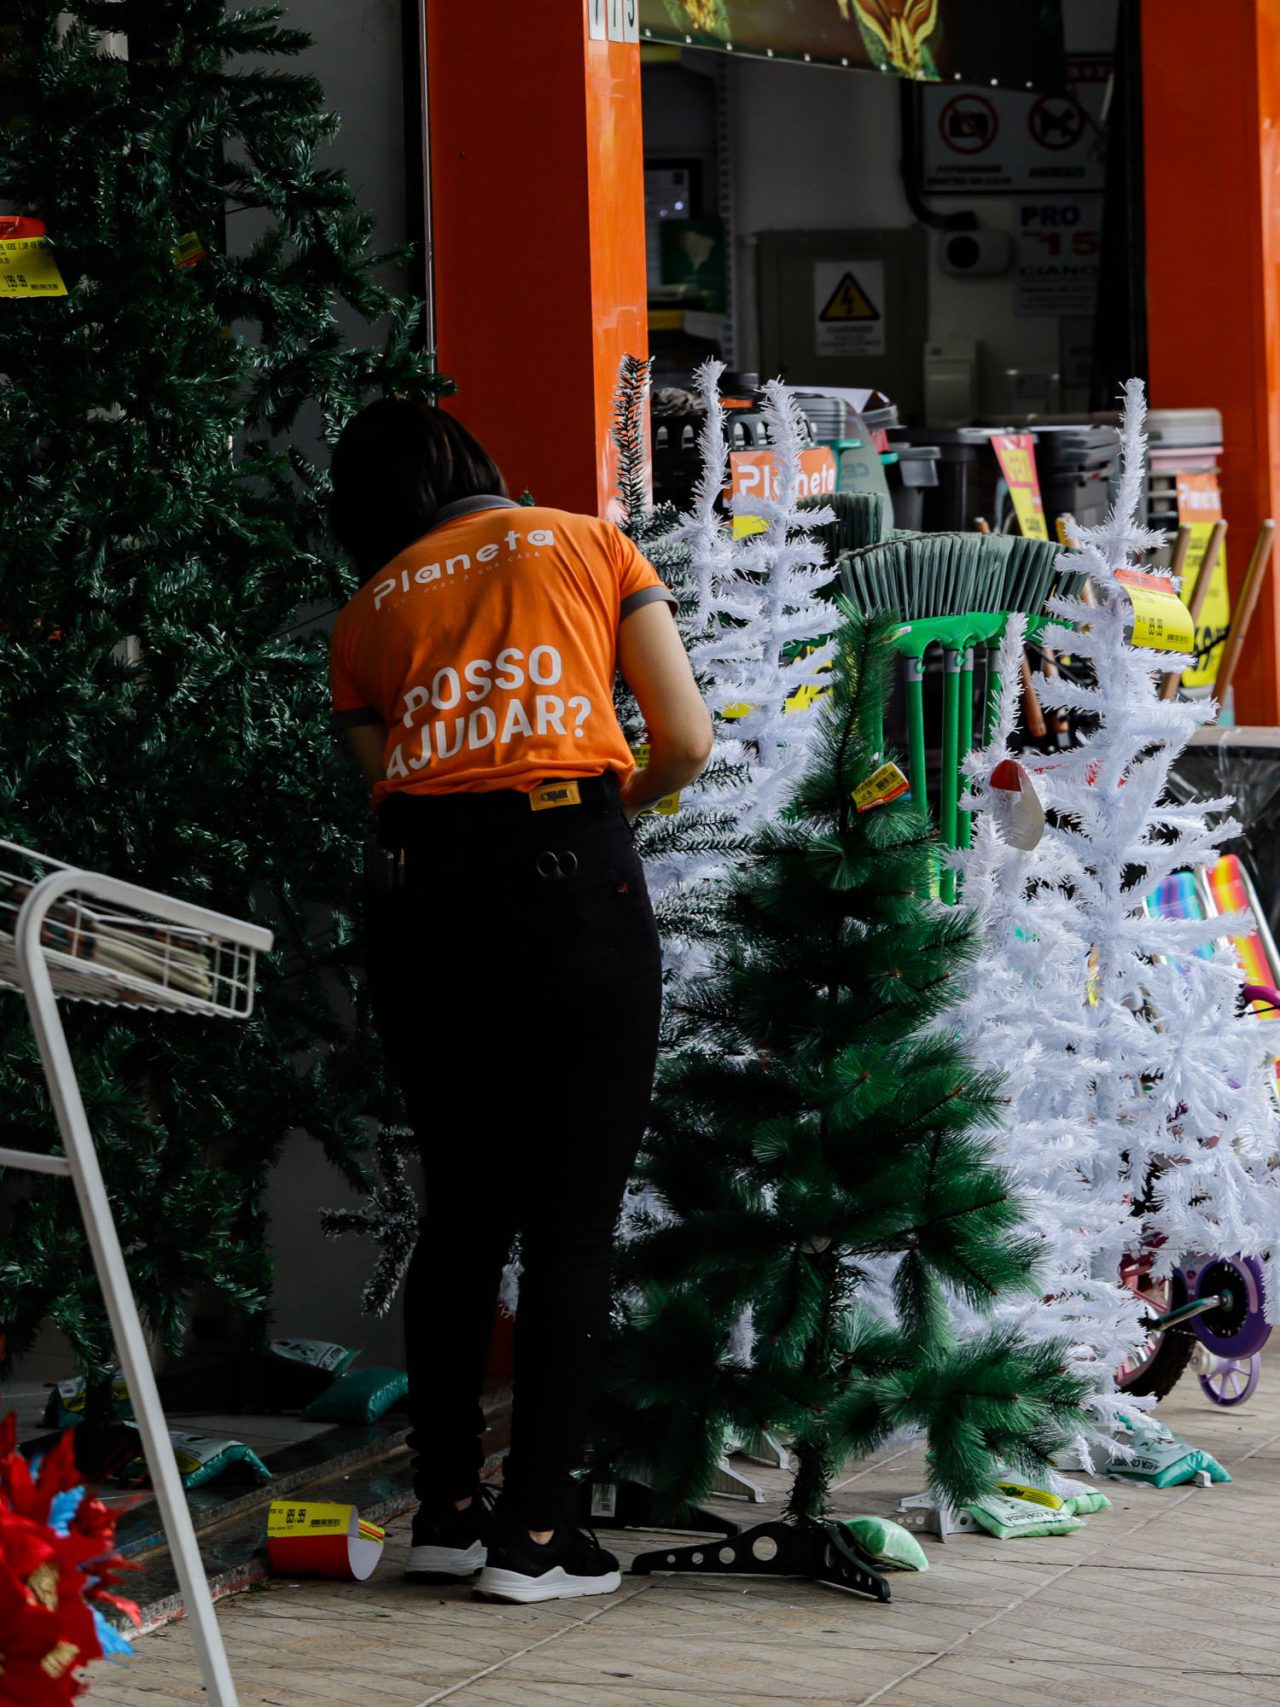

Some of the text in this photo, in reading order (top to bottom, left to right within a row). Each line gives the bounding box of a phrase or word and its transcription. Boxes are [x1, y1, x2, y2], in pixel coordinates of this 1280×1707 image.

[372, 529, 556, 611] Planeta
[507, 551, 541, 563] CASA
[402, 644, 563, 729] POSSO
[385, 694, 592, 781] AJUDAR?
